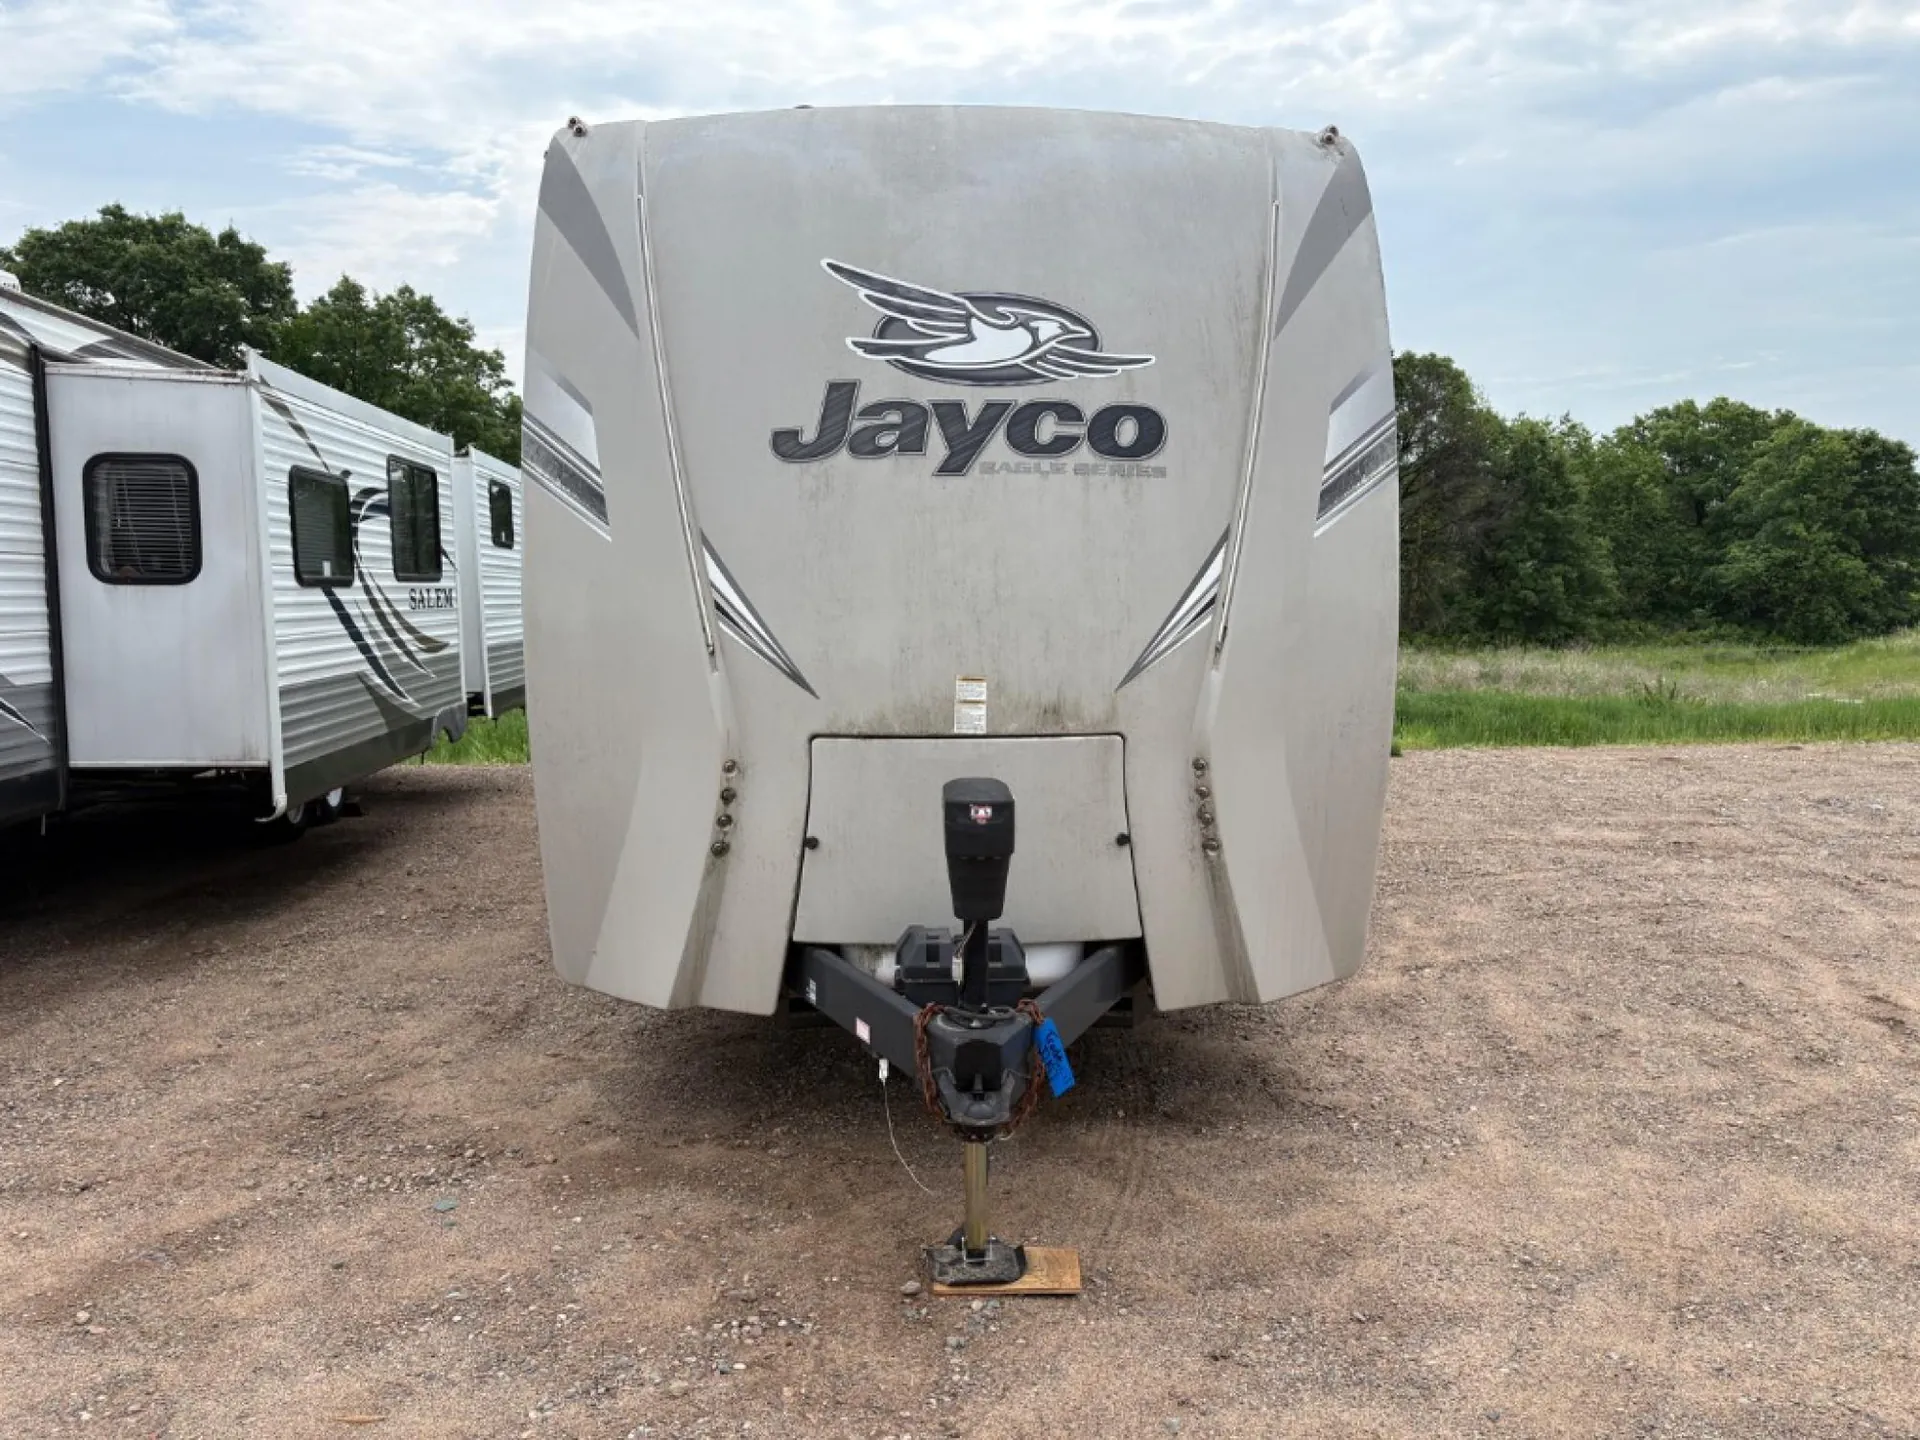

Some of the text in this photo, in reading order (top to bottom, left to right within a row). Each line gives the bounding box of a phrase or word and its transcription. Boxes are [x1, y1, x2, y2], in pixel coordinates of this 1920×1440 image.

[769, 378, 1169, 477] Jayco
[978, 461, 1167, 479] EAGLE SERIES
[409, 587, 454, 610] SALEM
